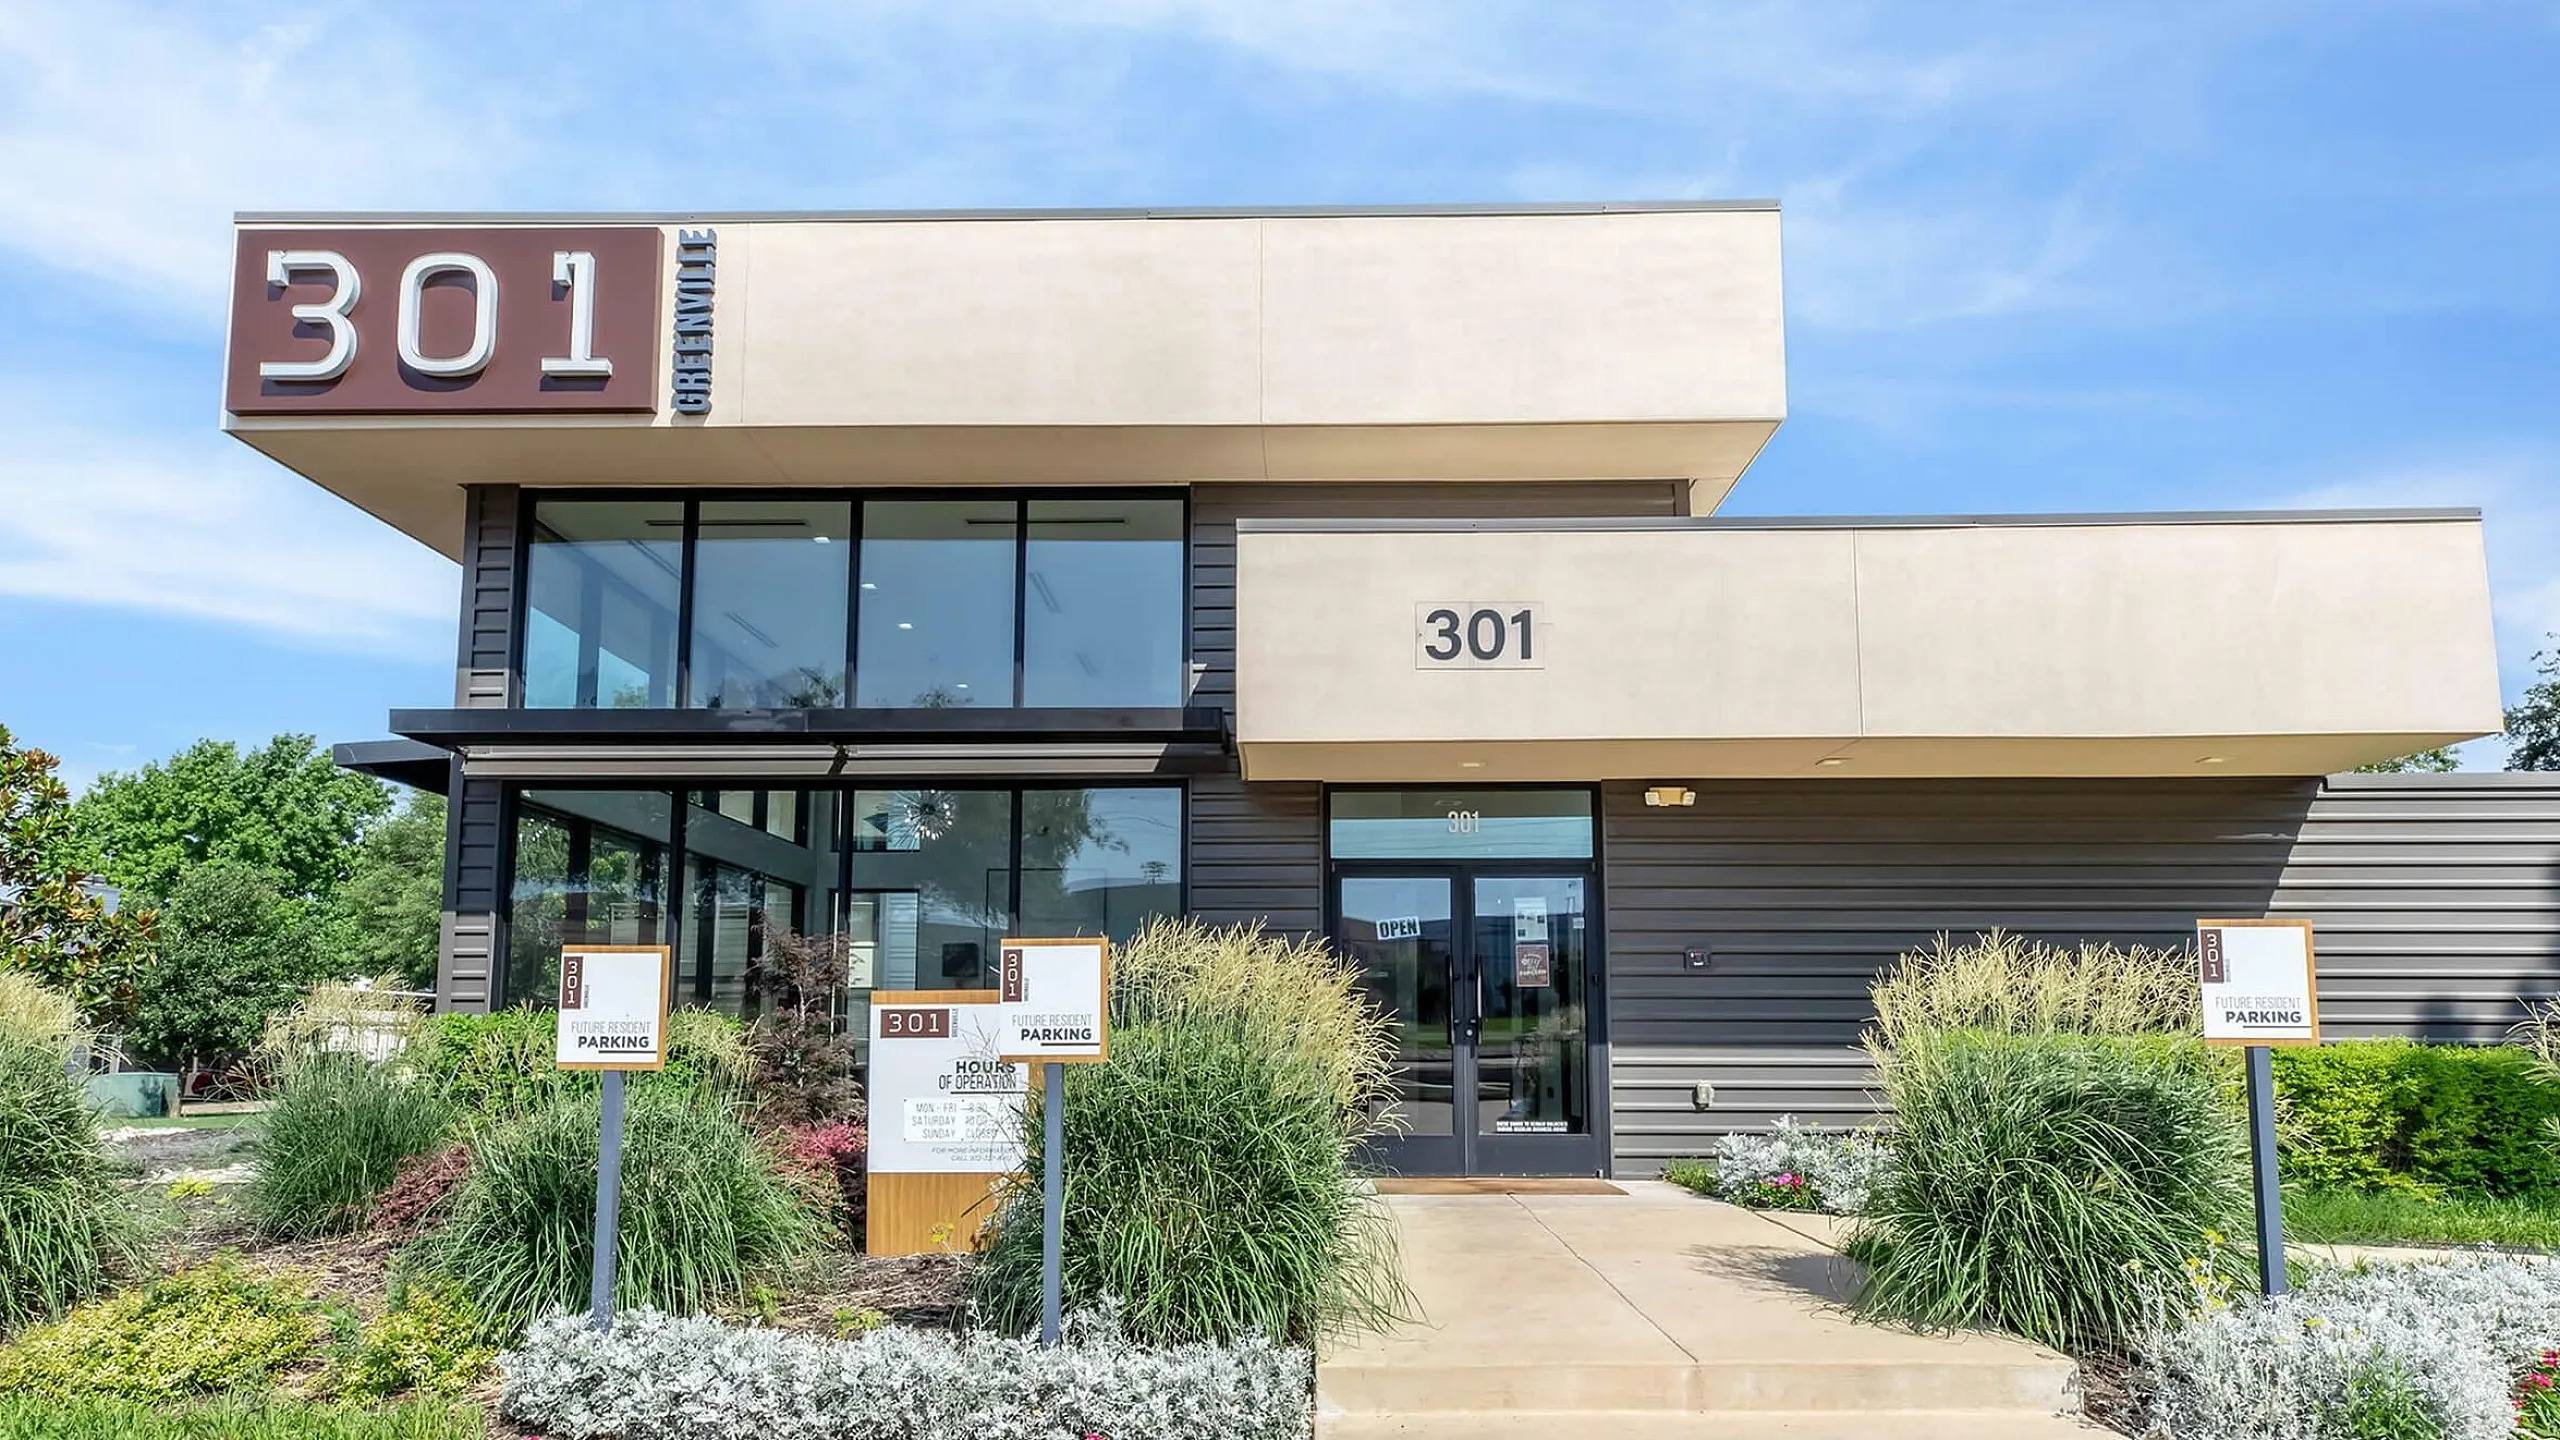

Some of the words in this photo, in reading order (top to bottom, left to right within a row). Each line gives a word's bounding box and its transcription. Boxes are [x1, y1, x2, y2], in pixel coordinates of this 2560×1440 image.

[260, 249, 613, 382] 301
[672, 228, 717, 415] GREENVILLE
[1425, 609, 1532, 660] 301
[1448, 811, 1479, 833] 301
[1379, 919, 1418, 938] OPEN
[2207, 934, 2219, 977] 301
[1008, 953, 1018, 996] 301
[567, 961, 578, 1004] 301
[2215, 996, 2252, 1009] FUTURE
[2255, 996, 2302, 1009] RESIDENT
[888, 1013, 940, 1033] 301
[1012, 1014, 1047, 1027] FUTURE
[1049, 1014, 1092, 1027] RESIDENT
[2225, 1011, 2302, 1023] PARKING
[571, 1021, 605, 1034] FUTURE
[608, 1021, 651, 1034] RESIDENT
[1021, 1028, 1092, 1041] PARKING
[577, 1036, 650, 1049] PARKING
[955, 1061, 1016, 1074] HOURS
[938, 1075, 953, 1089] OF
[955, 1075, 1017, 1090] OPERATION
[911, 1115, 956, 1126] SATURDAY
[922, 1128, 956, 1139] SUNDAY
